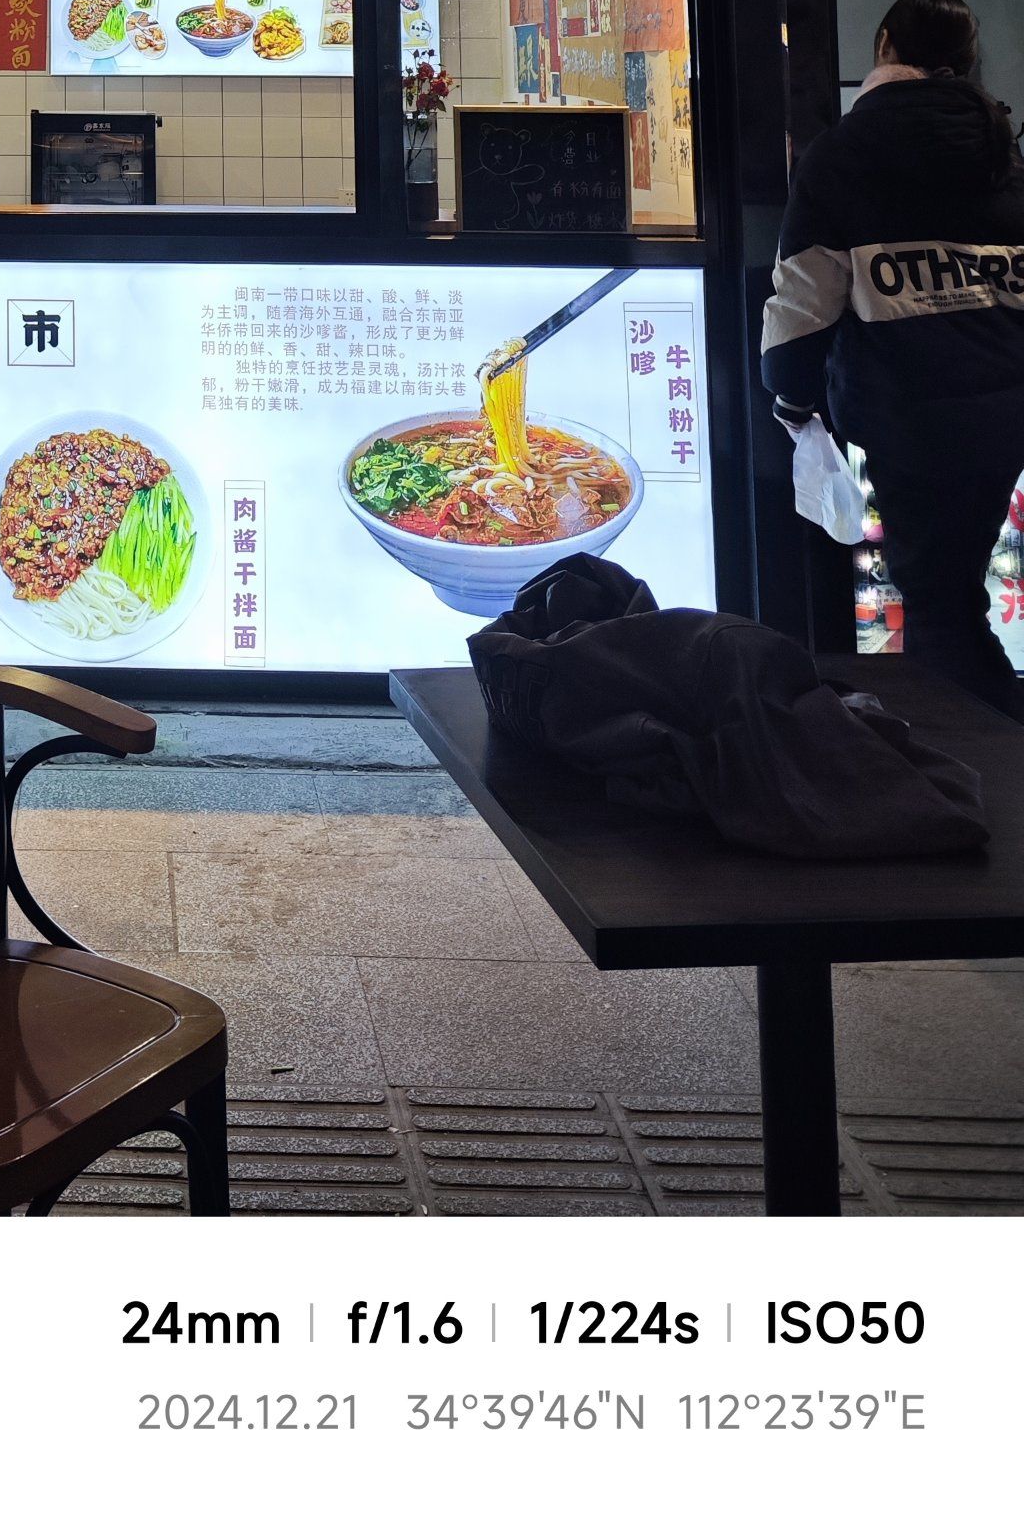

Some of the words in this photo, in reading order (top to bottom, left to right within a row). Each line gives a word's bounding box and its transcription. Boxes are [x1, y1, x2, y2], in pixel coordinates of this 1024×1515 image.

[630, 319, 656, 376] 沙嗲
[665, 345, 695, 465] 牛肉粉干
[233, 498, 258, 650] 肉酱干拌面
